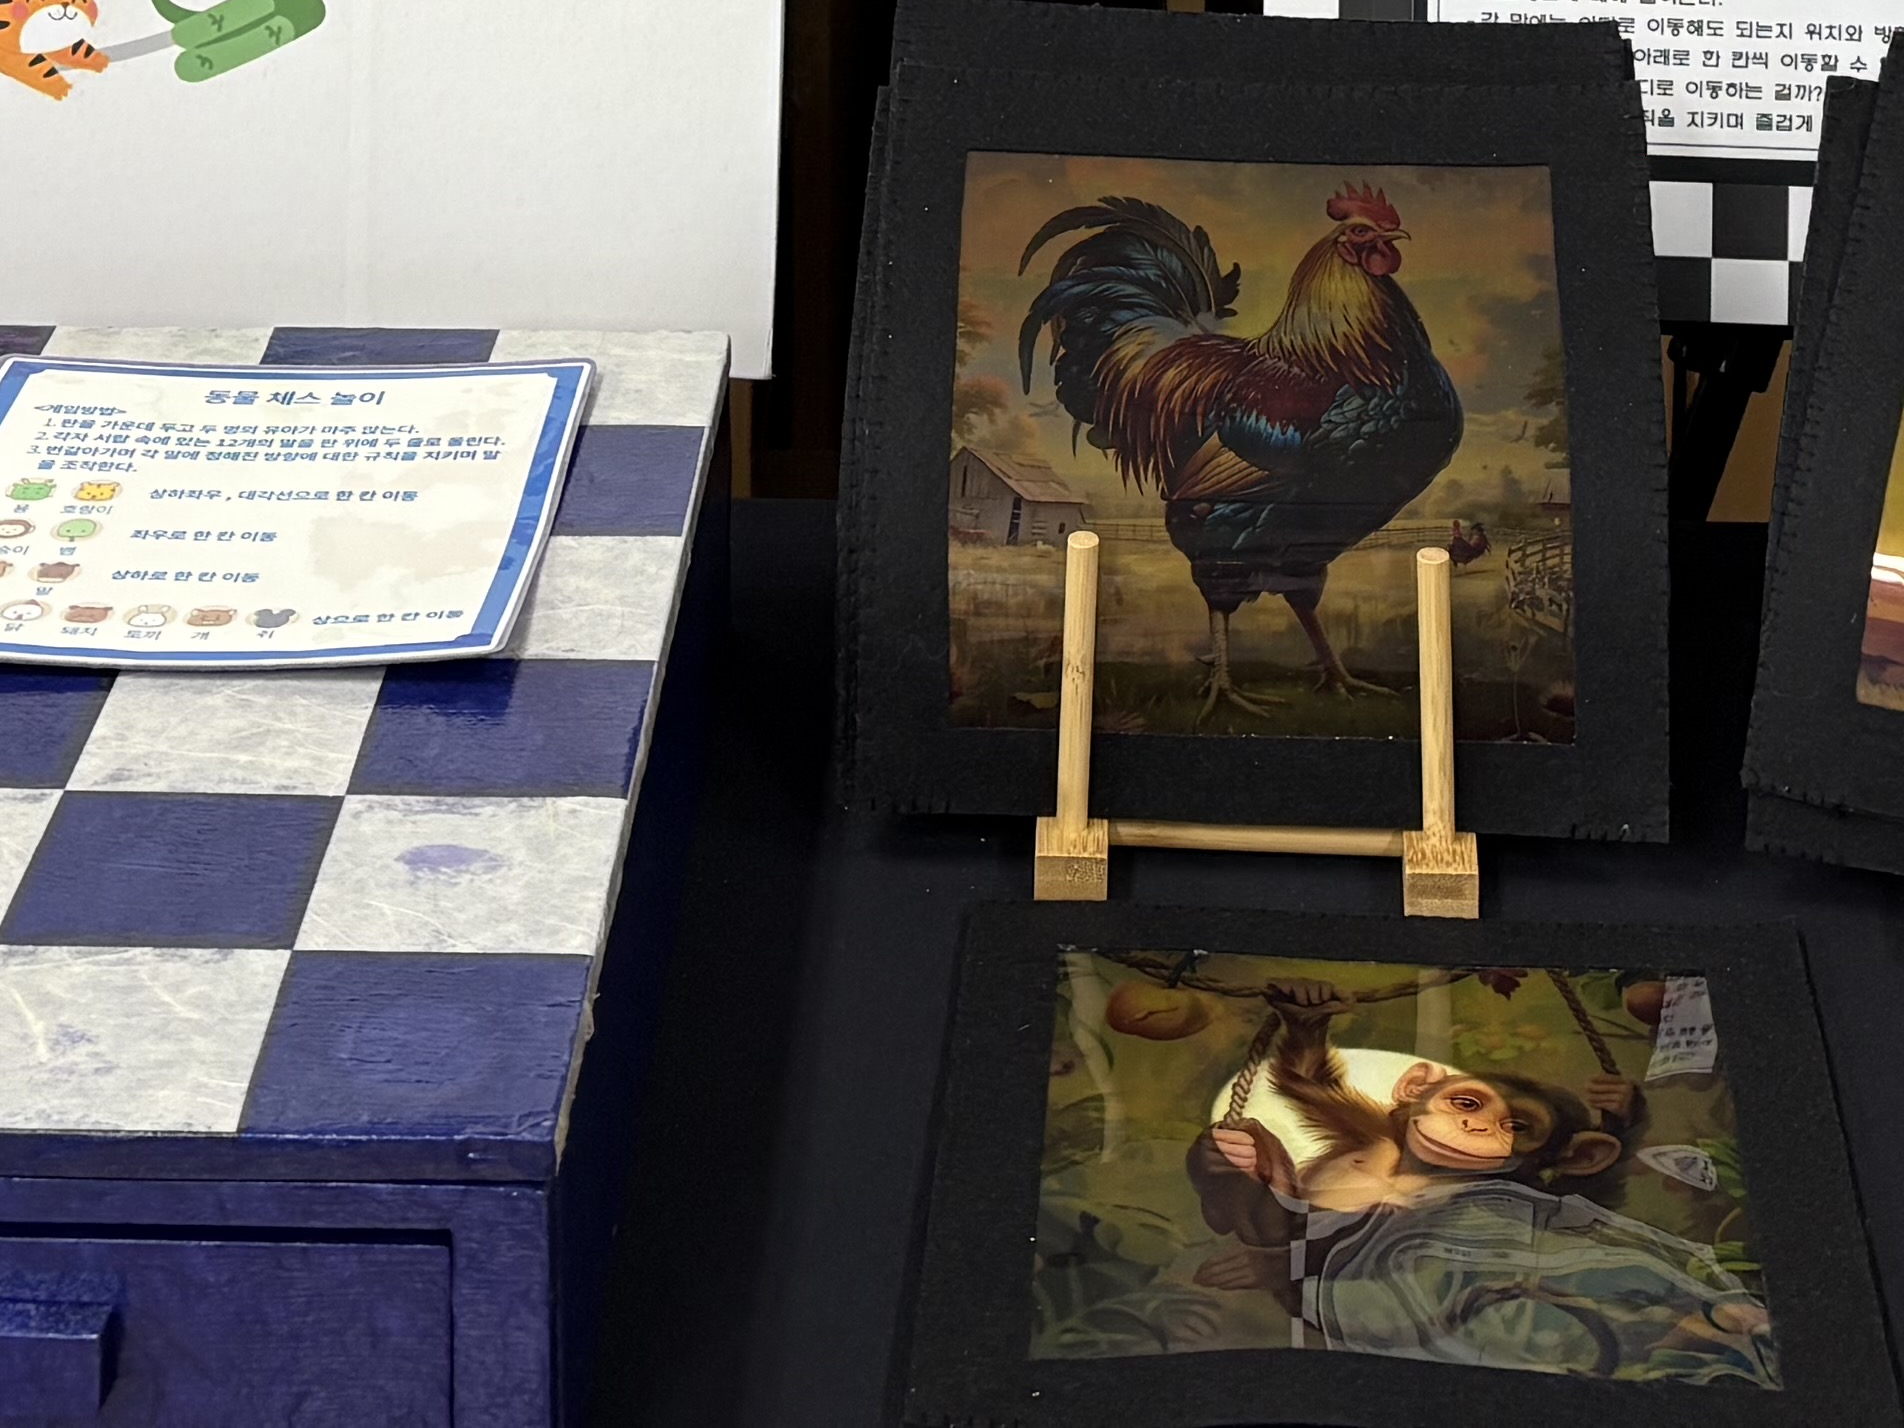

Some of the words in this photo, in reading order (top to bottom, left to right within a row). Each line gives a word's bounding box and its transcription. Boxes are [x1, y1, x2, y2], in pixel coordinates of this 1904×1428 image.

[1647, 17, 1724, 37] 이동해도
[1736, 20, 1793, 40] 되는지
[1804, 23, 1863, 43] 위치와
[1702, 49, 1721, 68] 한
[1731, 50, 1769, 70] 칸씩
[1780, 53, 1839, 73] 이동할
[1849, 55, 1868, 73] 수
[1685, 80, 1763, 100] 이동하는
[1774, 83, 1823, 102] 걸까?
[1686, 110, 1744, 130] 지키며
[1755, 112, 1813, 133] 즐겁게
[204, 389, 260, 405] 동물
[266, 390, 321, 406] 체스
[330, 390, 386, 406] 놀이
[34, 404, 127, 417] <게임방법>
